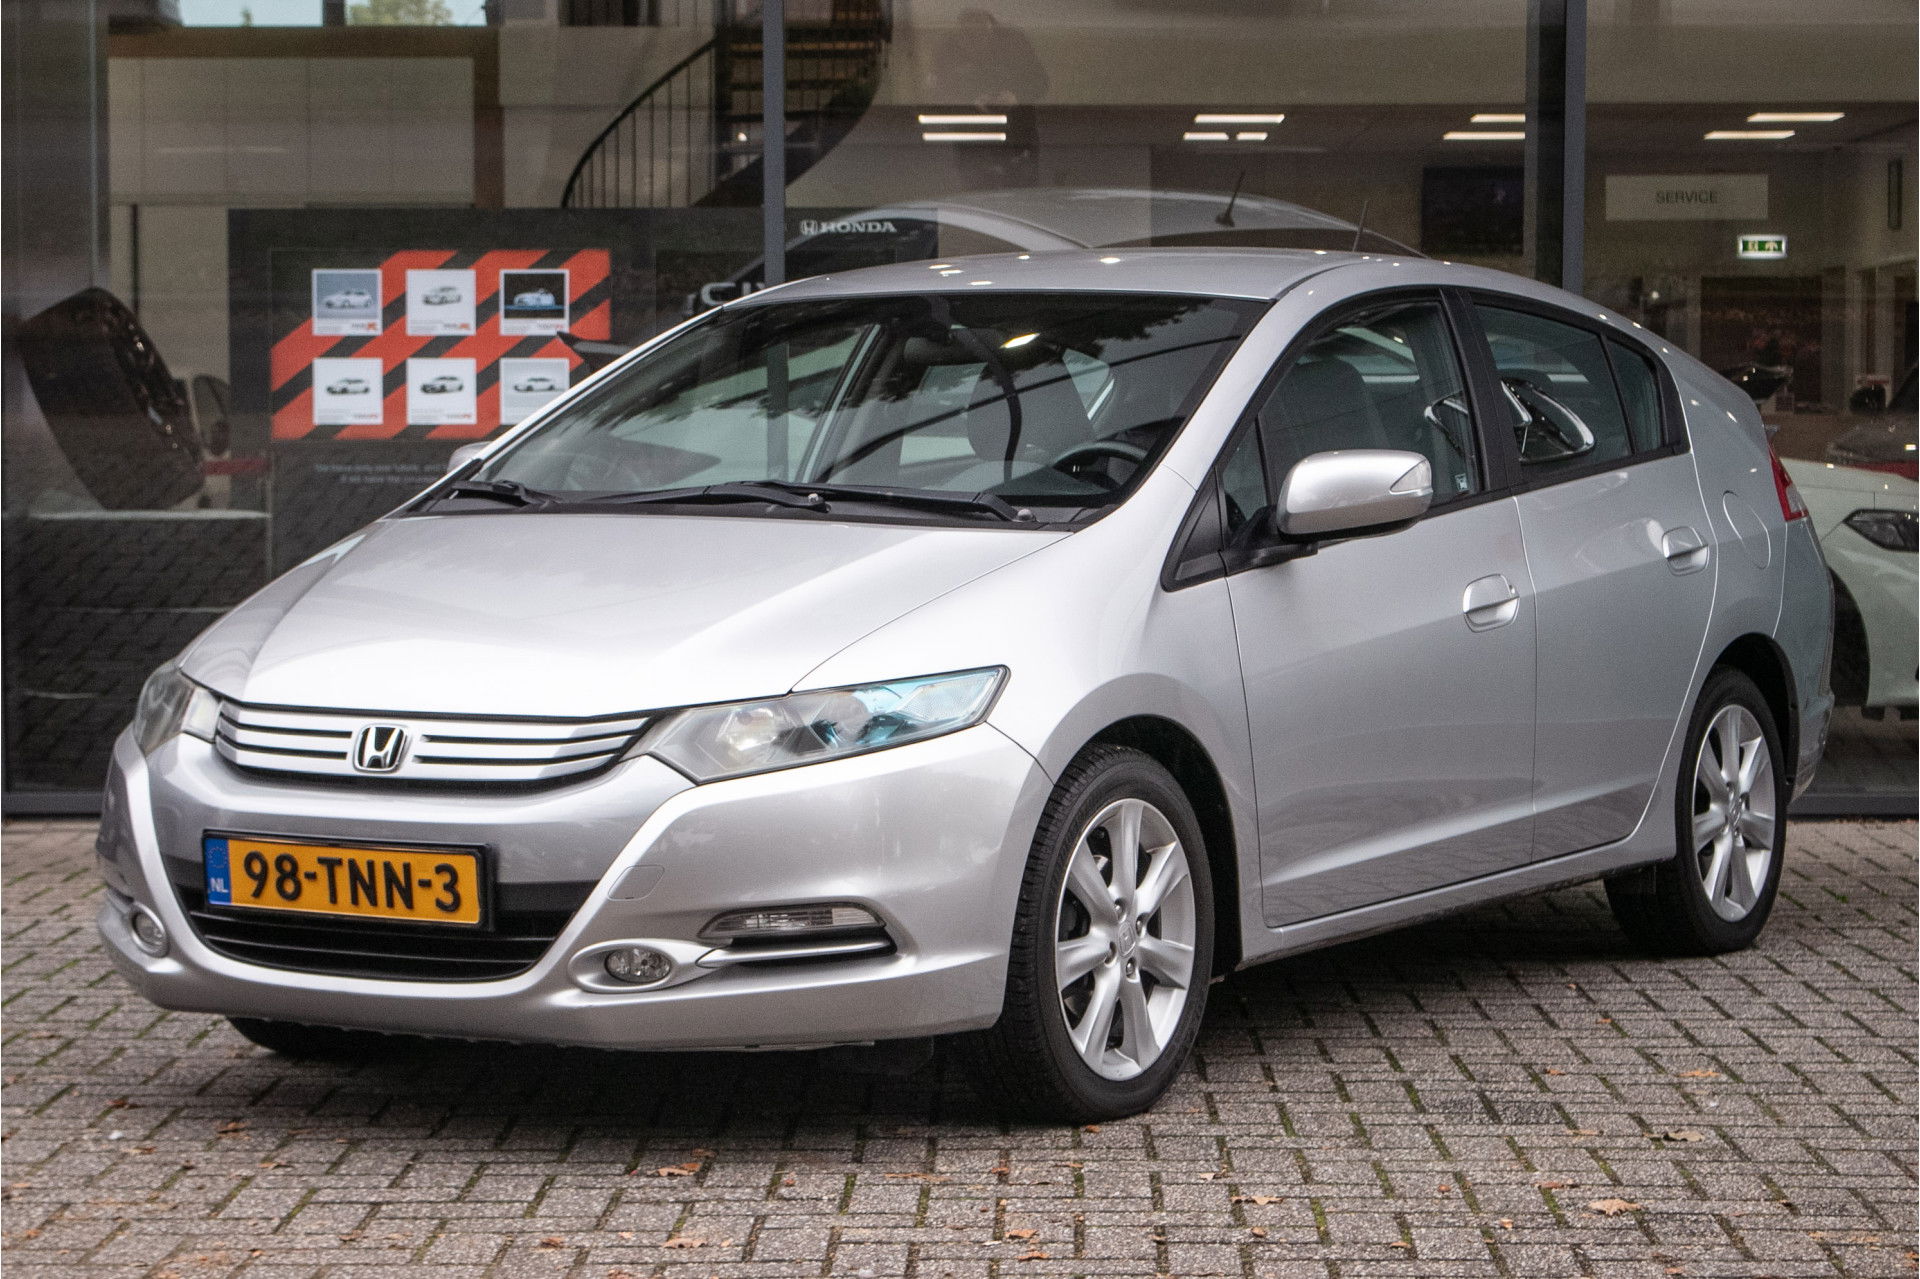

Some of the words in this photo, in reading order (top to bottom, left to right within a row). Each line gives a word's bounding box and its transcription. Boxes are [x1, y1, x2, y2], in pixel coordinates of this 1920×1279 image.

[1655, 190, 1718, 204] SERVICE
[819, 220, 898, 233] HONDA
[209, 877, 229, 894] NL
[242, 850, 462, 914] 98-TNN-3
